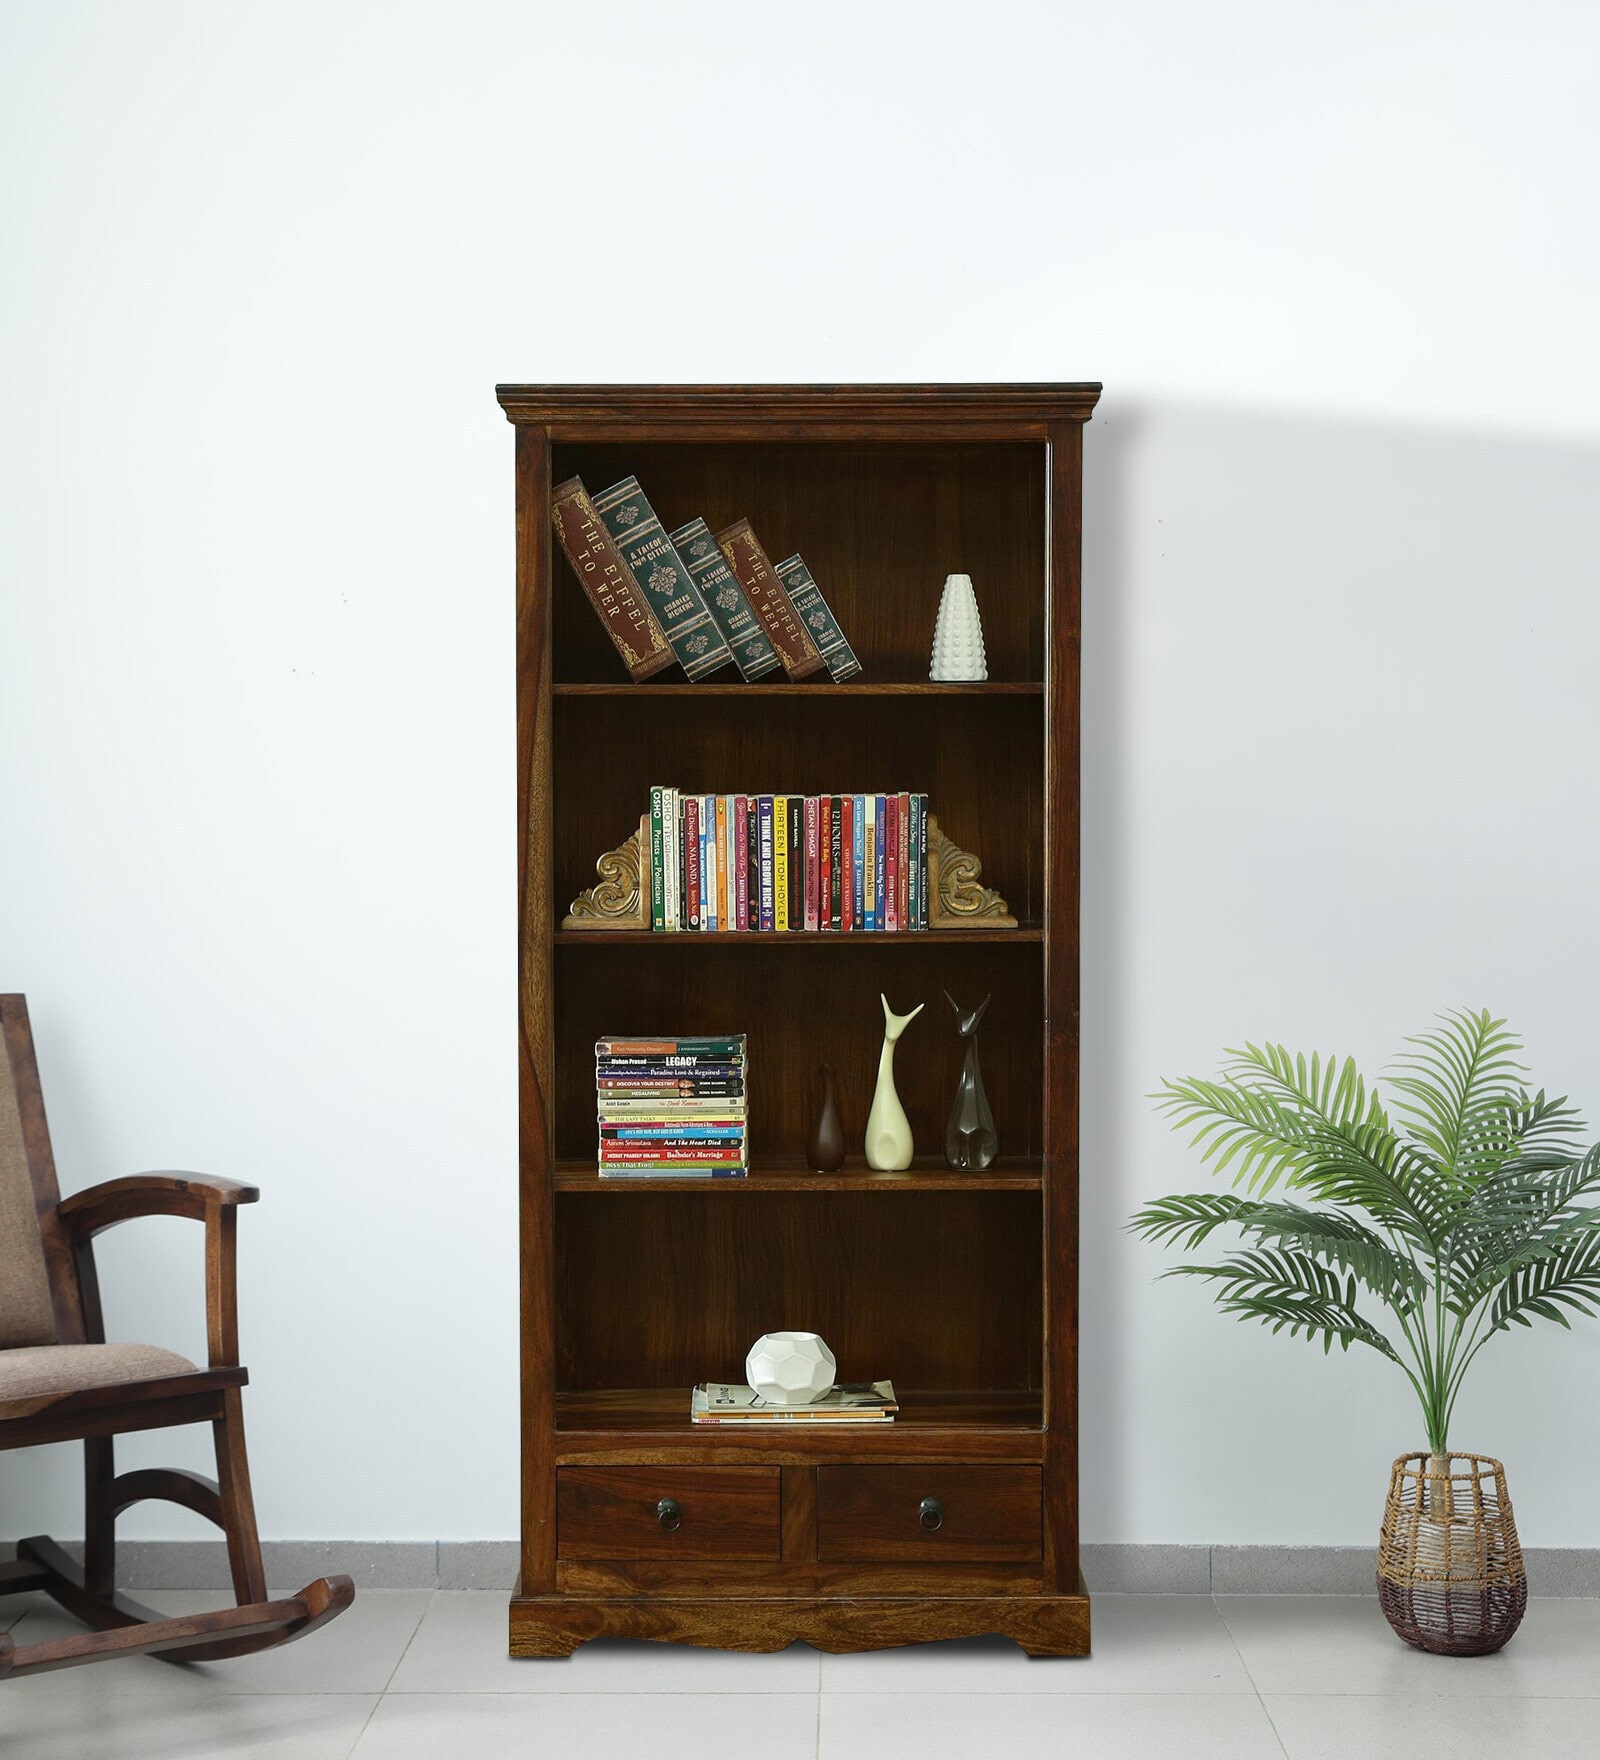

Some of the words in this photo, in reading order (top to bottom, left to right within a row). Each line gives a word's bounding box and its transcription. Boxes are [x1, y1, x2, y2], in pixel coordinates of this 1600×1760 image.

[647, 543, 672, 561] CITIES
[578, 550, 596, 572] TO
[596, 583, 620, 618] WER
[581, 520, 605, 553] THE
[604, 564, 646, 631] EIFFEL
[664, 594, 690, 613] CHARLES
[667, 600, 694, 620] DICKENS
[746, 576, 760, 595] TO
[761, 603, 780, 631] WER
[748, 553, 768, 580] THE
[766, 588, 800, 642] EIFFEL
[653, 792, 662, 818] OSHO
[663, 793, 672, 821] OSHO
[688, 803, 696, 816] Last
[832, 810, 841, 819] 12
[687, 817, 697, 842] Disciple
[761, 815, 771, 840] THINK
[832, 821, 841, 857] HOURS
[654, 829, 662, 855] Priests
[761, 841, 771, 859] AND
[866, 828, 874, 863] Benjamin
[690, 846, 698, 885] NALANDA
[761, 860, 771, 886] GROW
[655, 867, 664, 905] Politicians
[867, 864, 875, 897] Franklin
[762, 888, 772, 907] RICH
[666, 1056, 697, 1067] LEGACY
